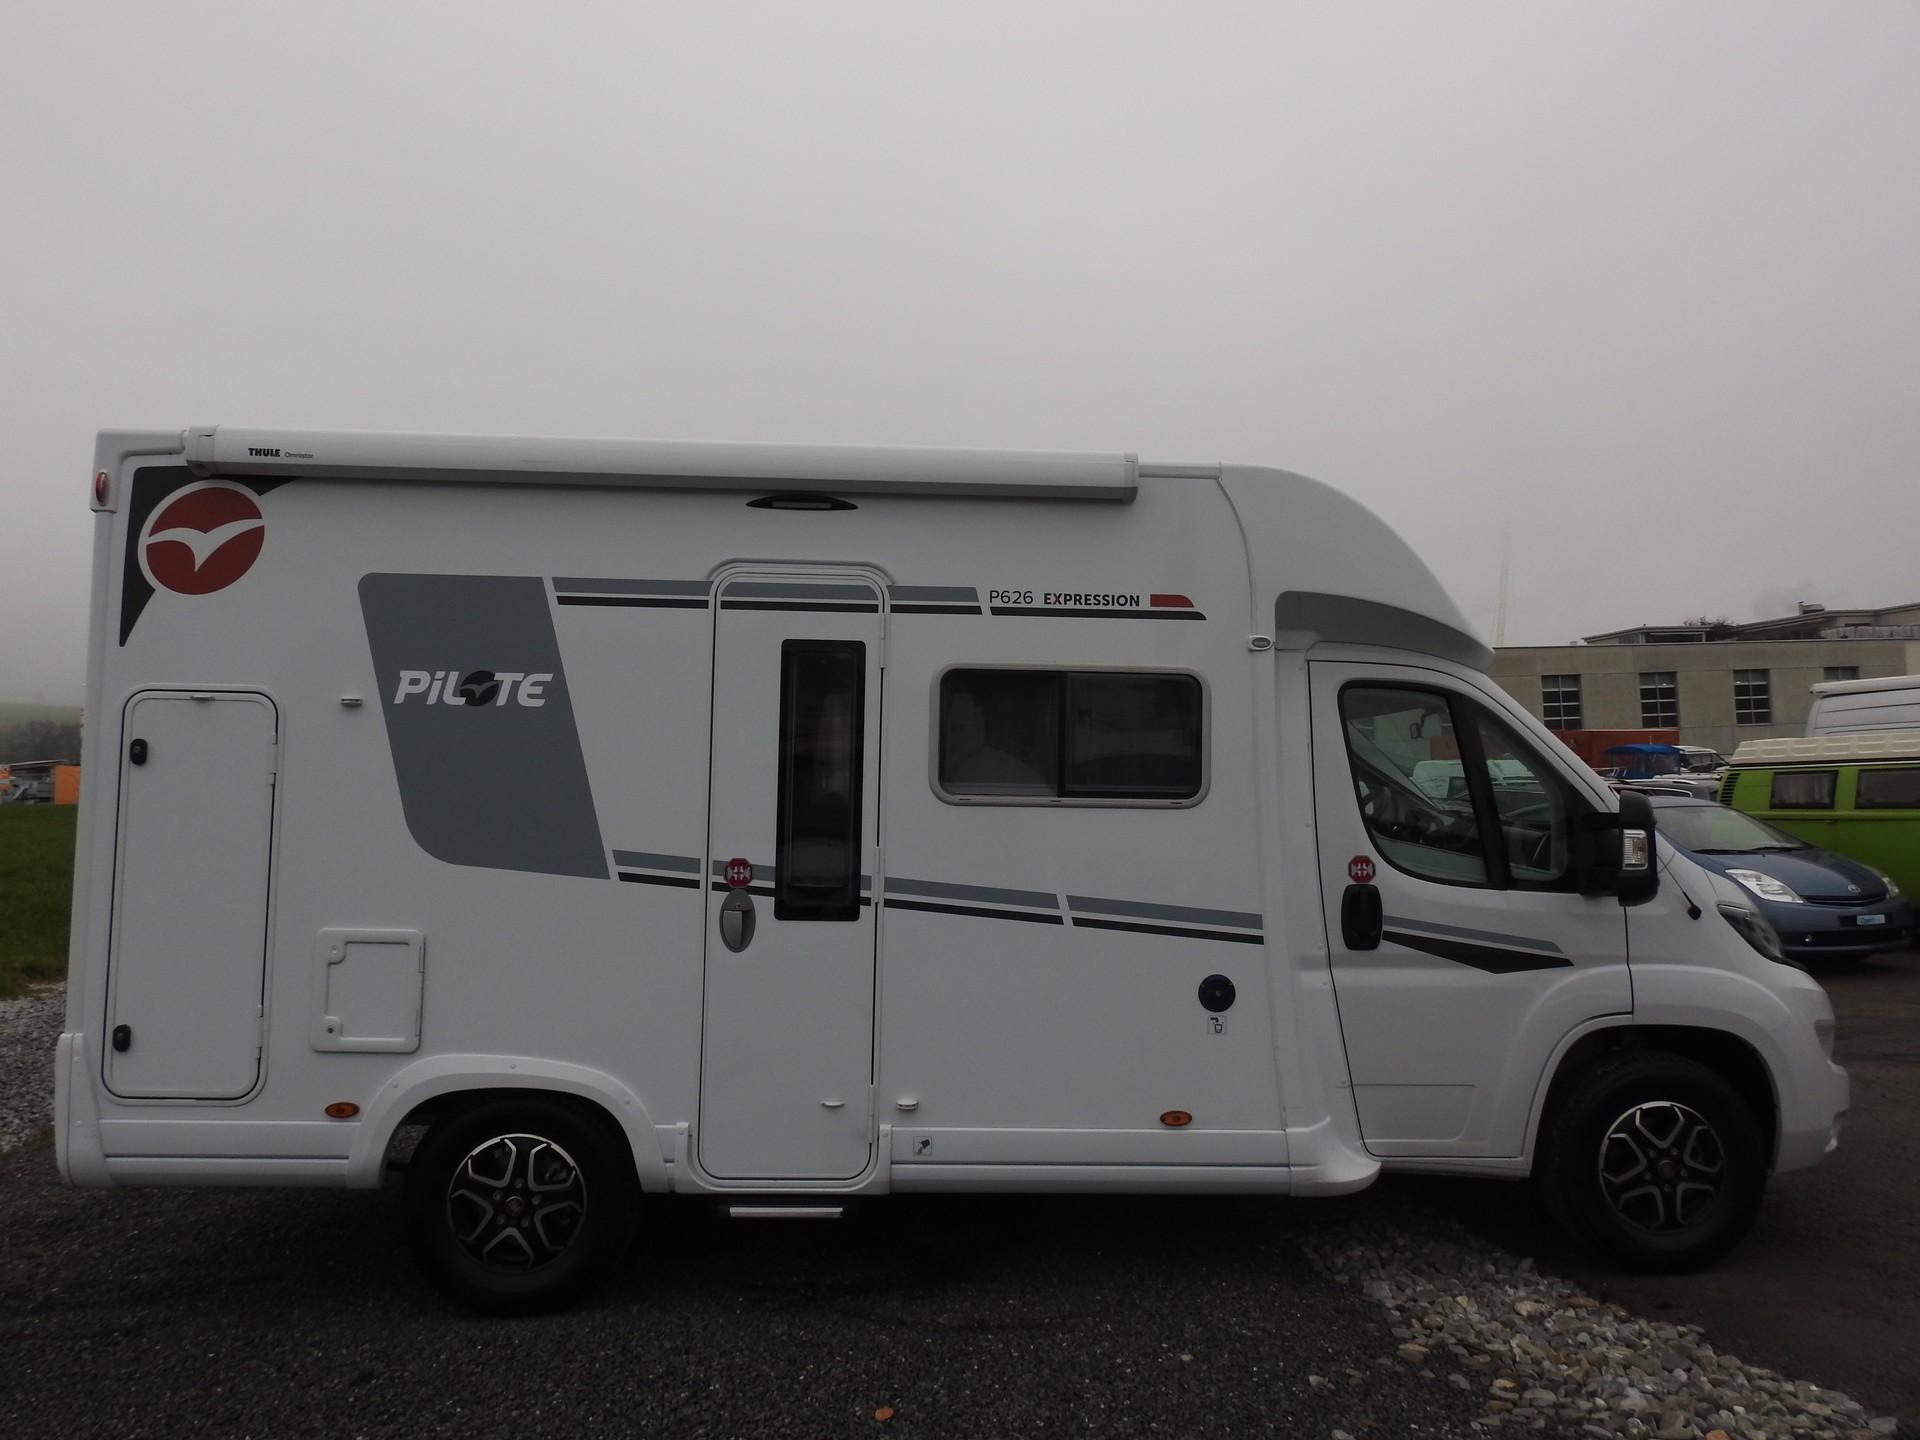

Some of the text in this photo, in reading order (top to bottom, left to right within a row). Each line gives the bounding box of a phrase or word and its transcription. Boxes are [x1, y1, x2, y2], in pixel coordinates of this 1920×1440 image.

[248, 447, 314, 459] THULE Omnistor
[989, 590, 1140, 607] P626 EXPRESSION
